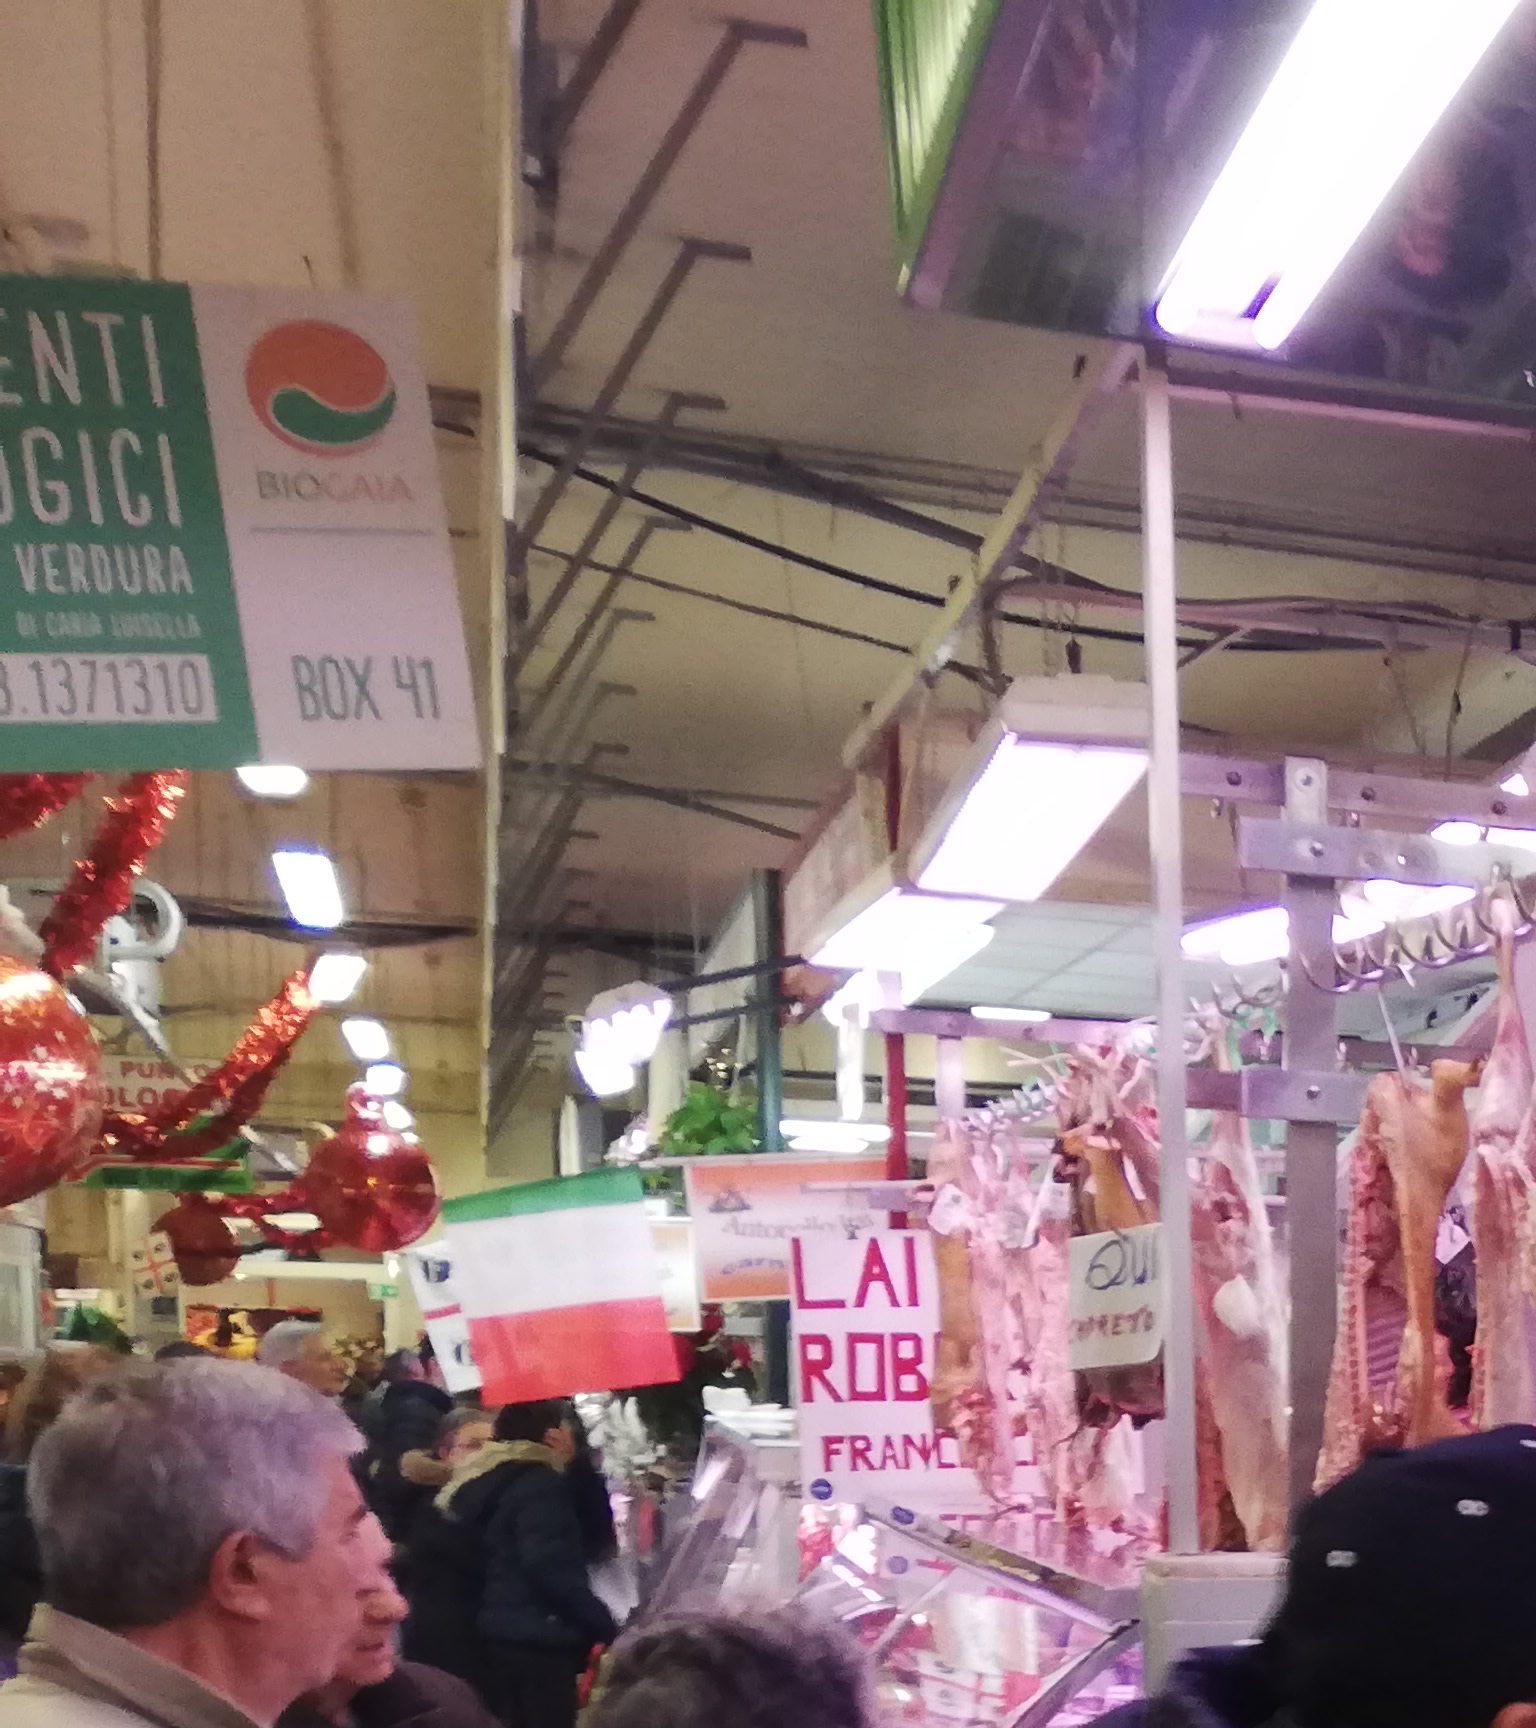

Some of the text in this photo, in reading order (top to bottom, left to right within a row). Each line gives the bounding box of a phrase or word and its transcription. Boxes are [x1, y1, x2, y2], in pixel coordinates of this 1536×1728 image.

[0, 426, 182, 529] GICI
[257, 469, 415, 501] BIOGAIA
[14, 542, 195, 595] VERDURA
[291, 654, 441, 721] BOX 41
[791, 1236, 921, 1309] LAI
[799, 1332, 941, 1403] ROB
